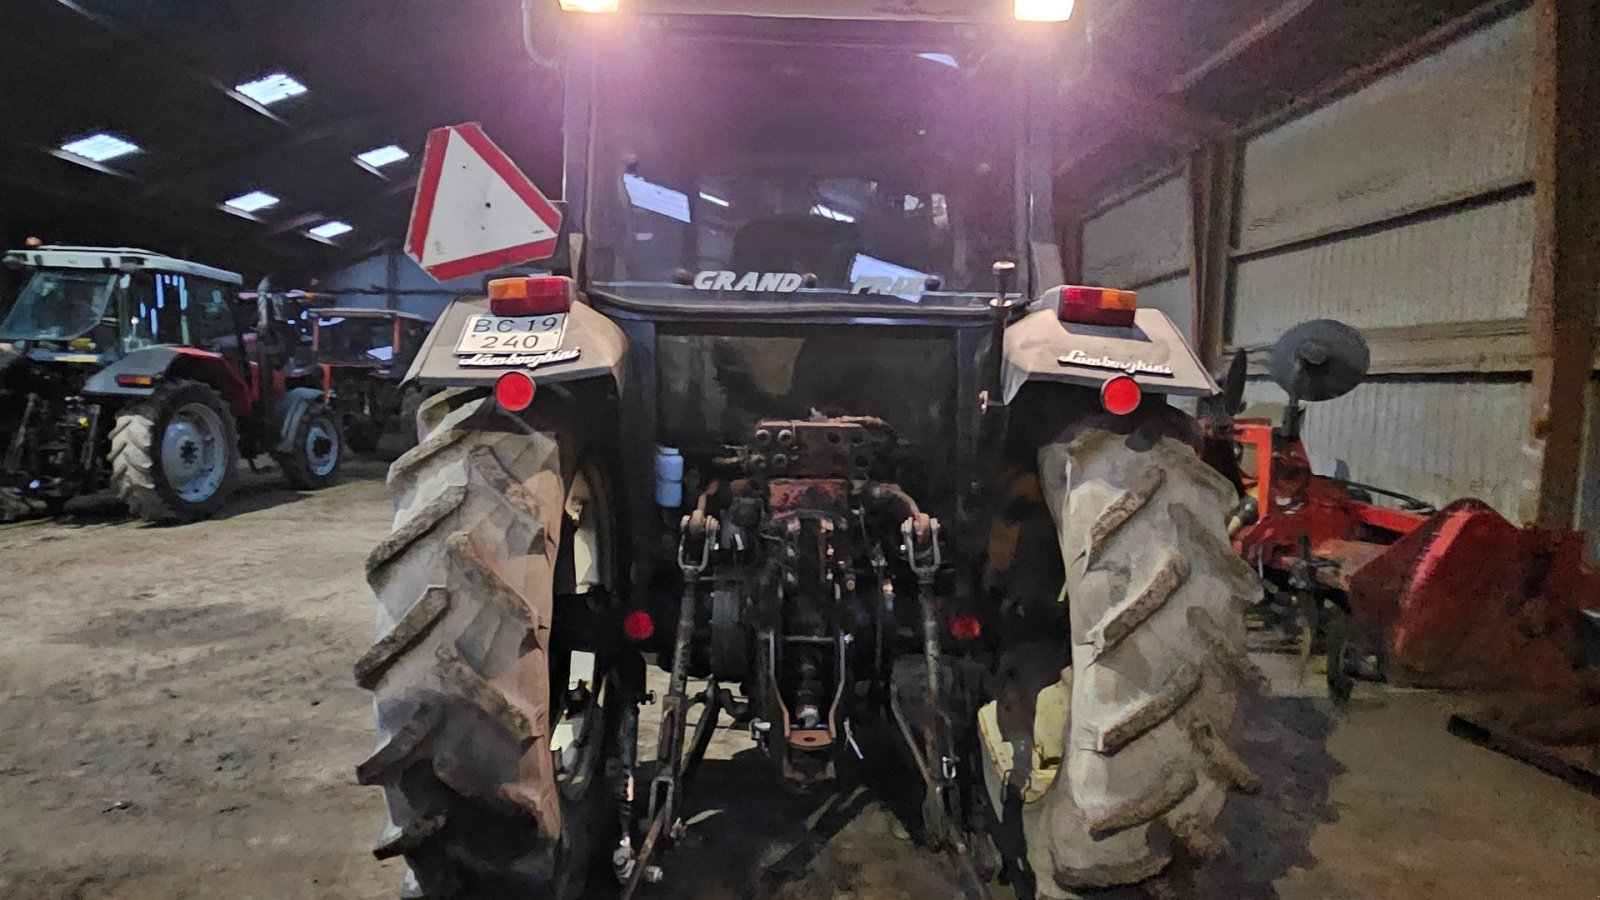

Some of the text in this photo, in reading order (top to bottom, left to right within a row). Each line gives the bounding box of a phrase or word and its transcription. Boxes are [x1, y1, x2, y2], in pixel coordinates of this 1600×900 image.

[693, 270, 802, 293] GRAND
[473, 316, 557, 333] BC 19
[480, 334, 540, 349] 240
[1058, 349, 1173, 374] Lamborghini
